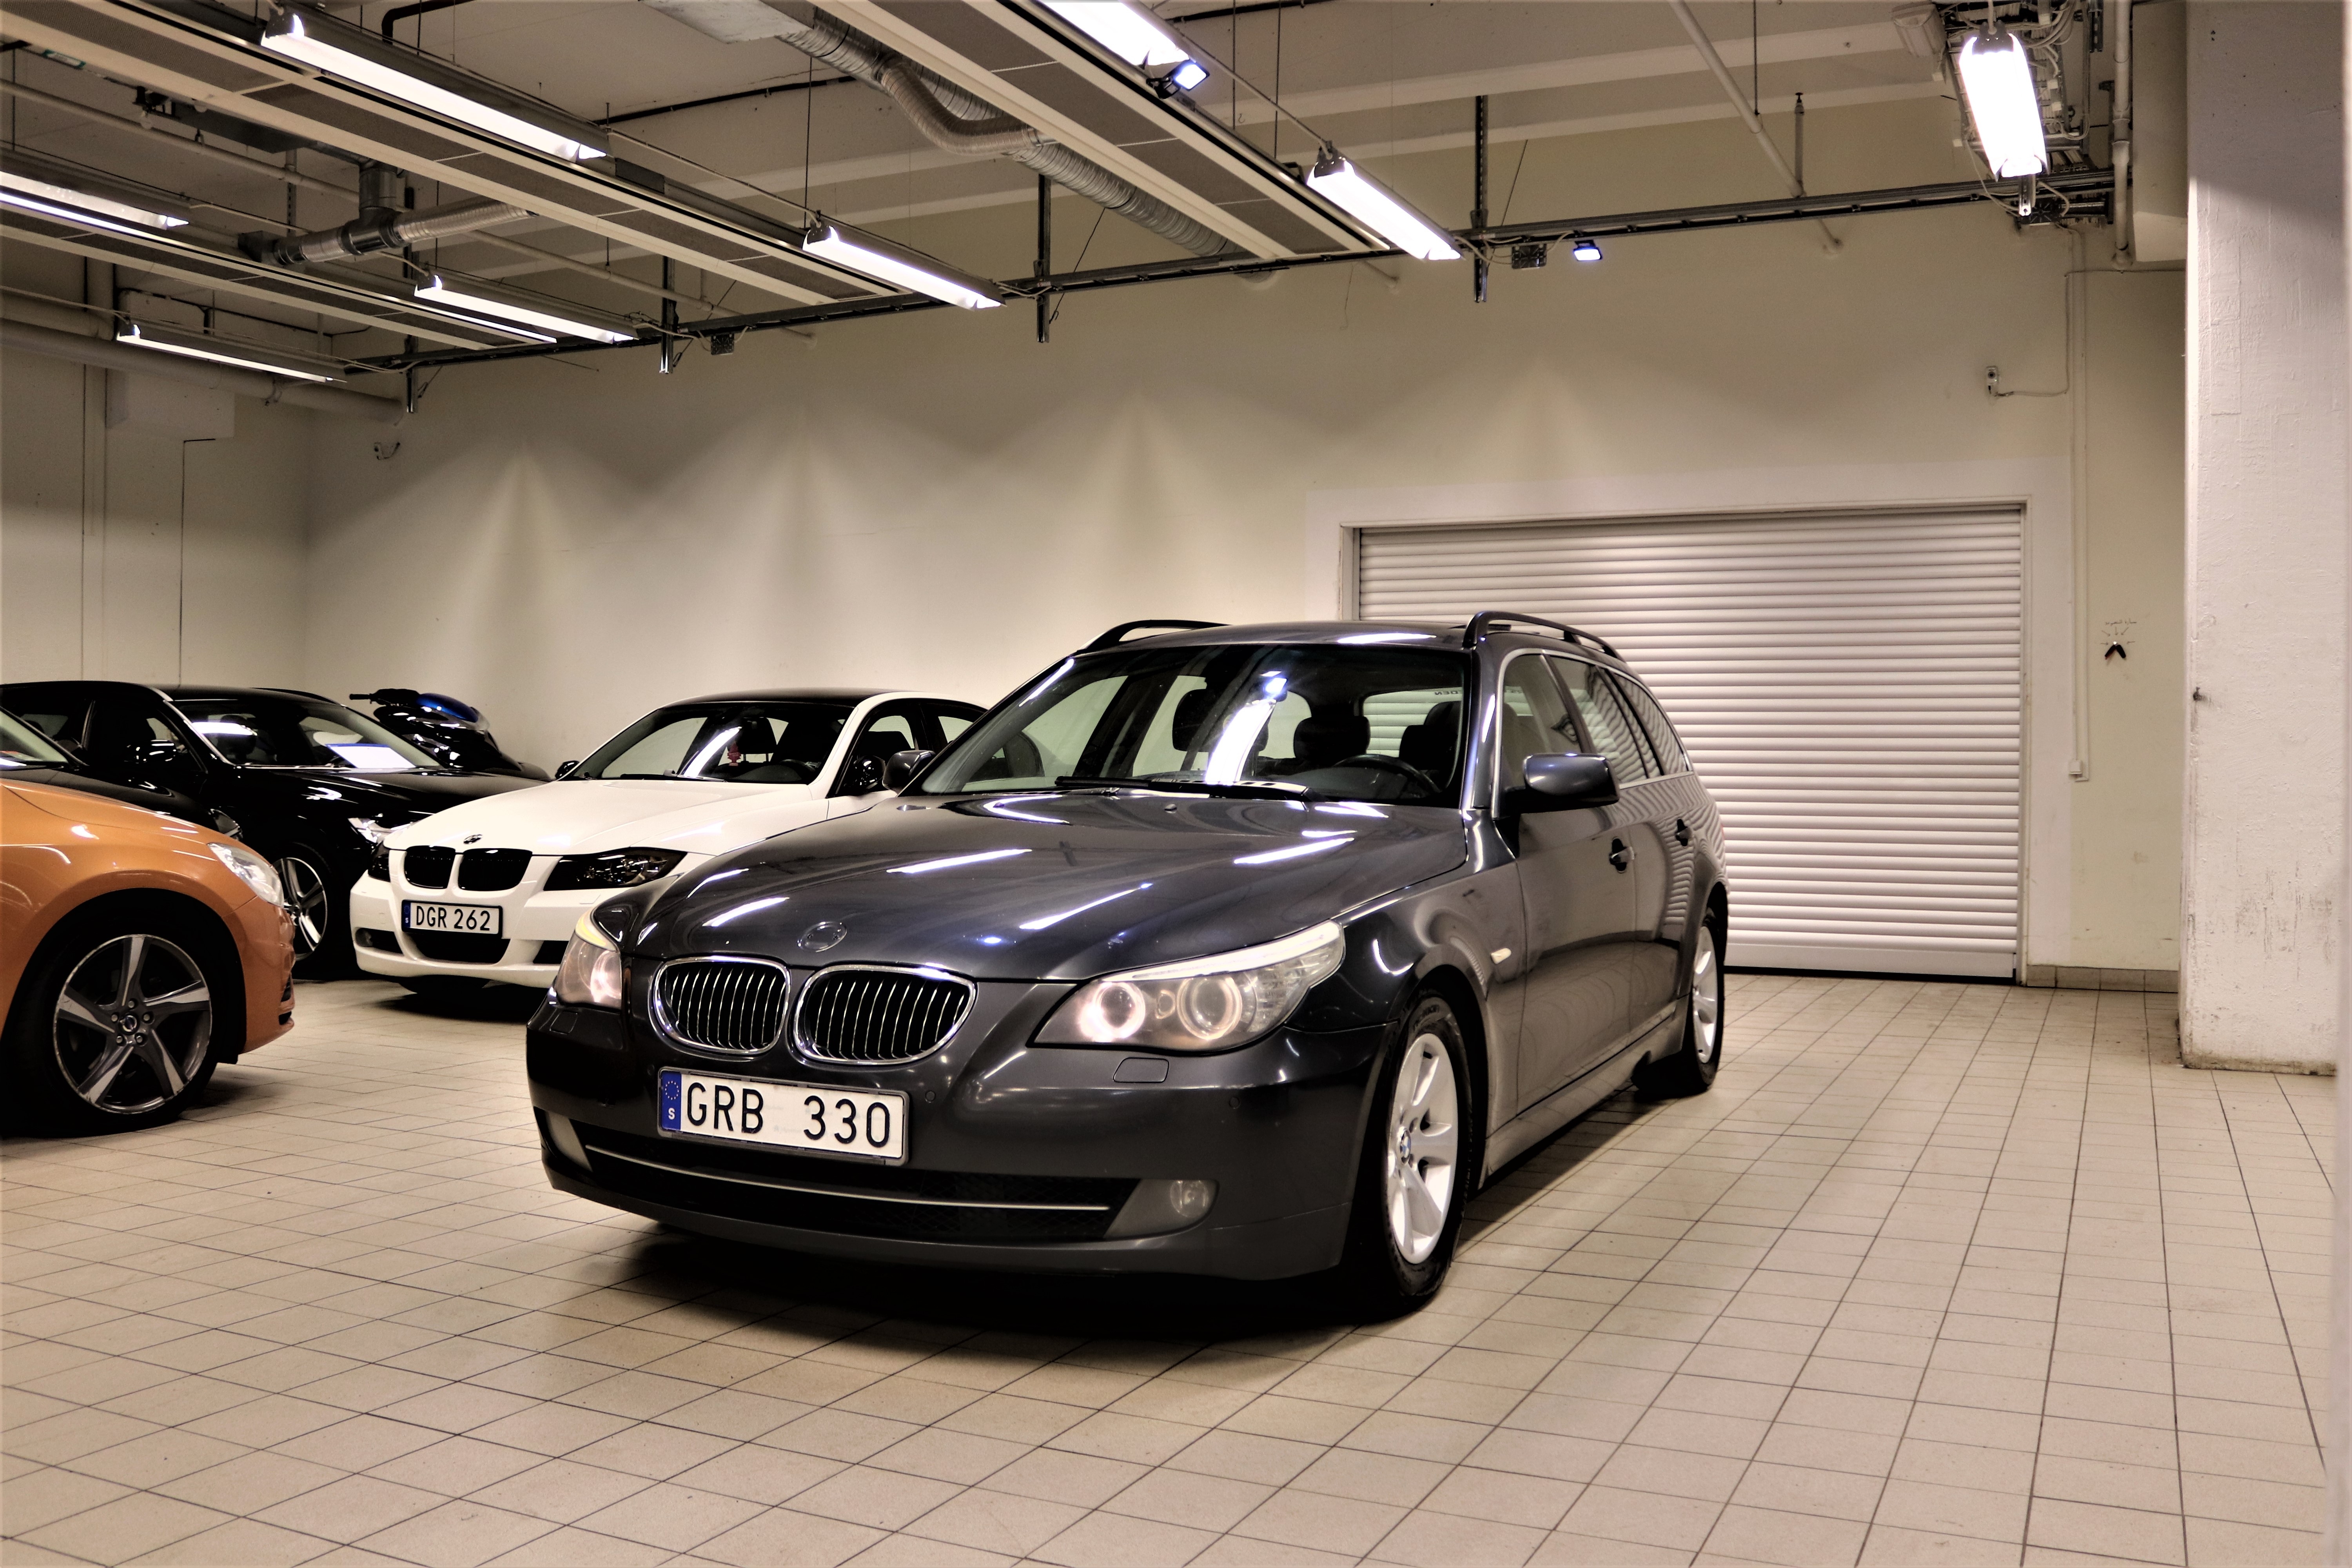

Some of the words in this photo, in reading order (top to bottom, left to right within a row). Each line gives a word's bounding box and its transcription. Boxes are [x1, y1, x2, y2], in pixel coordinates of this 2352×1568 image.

[416, 906, 447, 928] DGR
[454, 908, 490, 931] 262
[668, 1107, 675, 1120] S
[687, 1082, 764, 1134] GRB
[804, 1095, 891, 1148] 330
